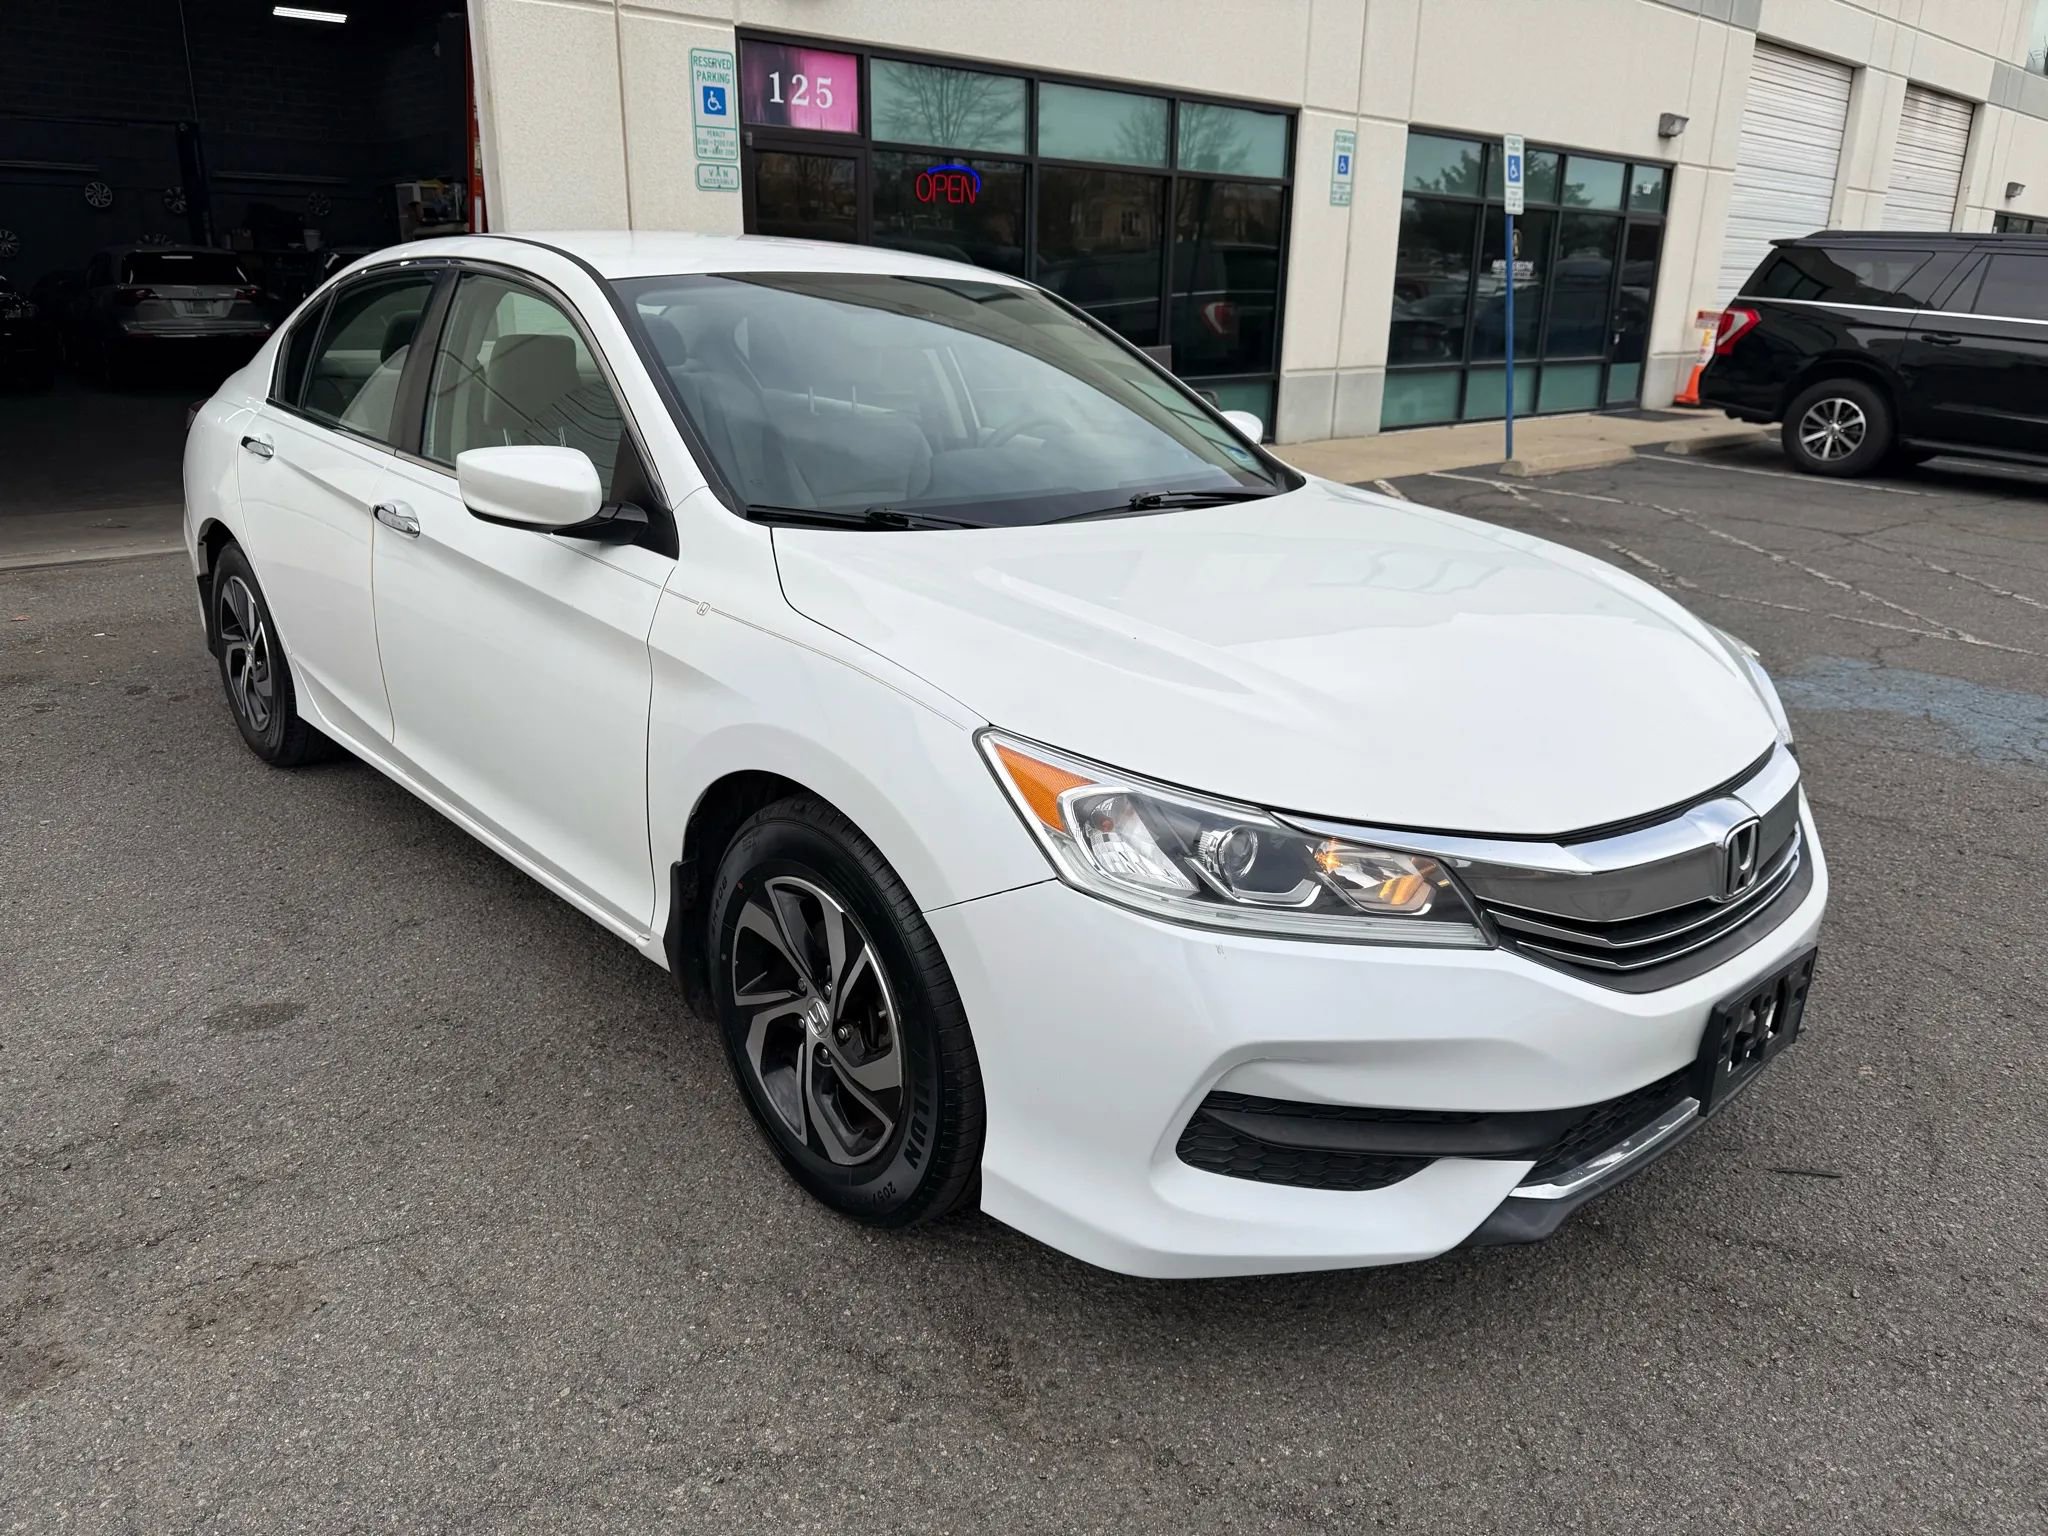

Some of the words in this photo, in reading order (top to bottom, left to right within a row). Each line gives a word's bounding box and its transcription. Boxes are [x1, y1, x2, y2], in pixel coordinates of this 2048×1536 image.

[693, 55, 732, 70] RESERVED
[696, 70, 731, 84] PARKING
[769, 72, 833, 108] 125
[709, 167, 728, 177] VAN
[916, 172, 976, 204] OPEN
